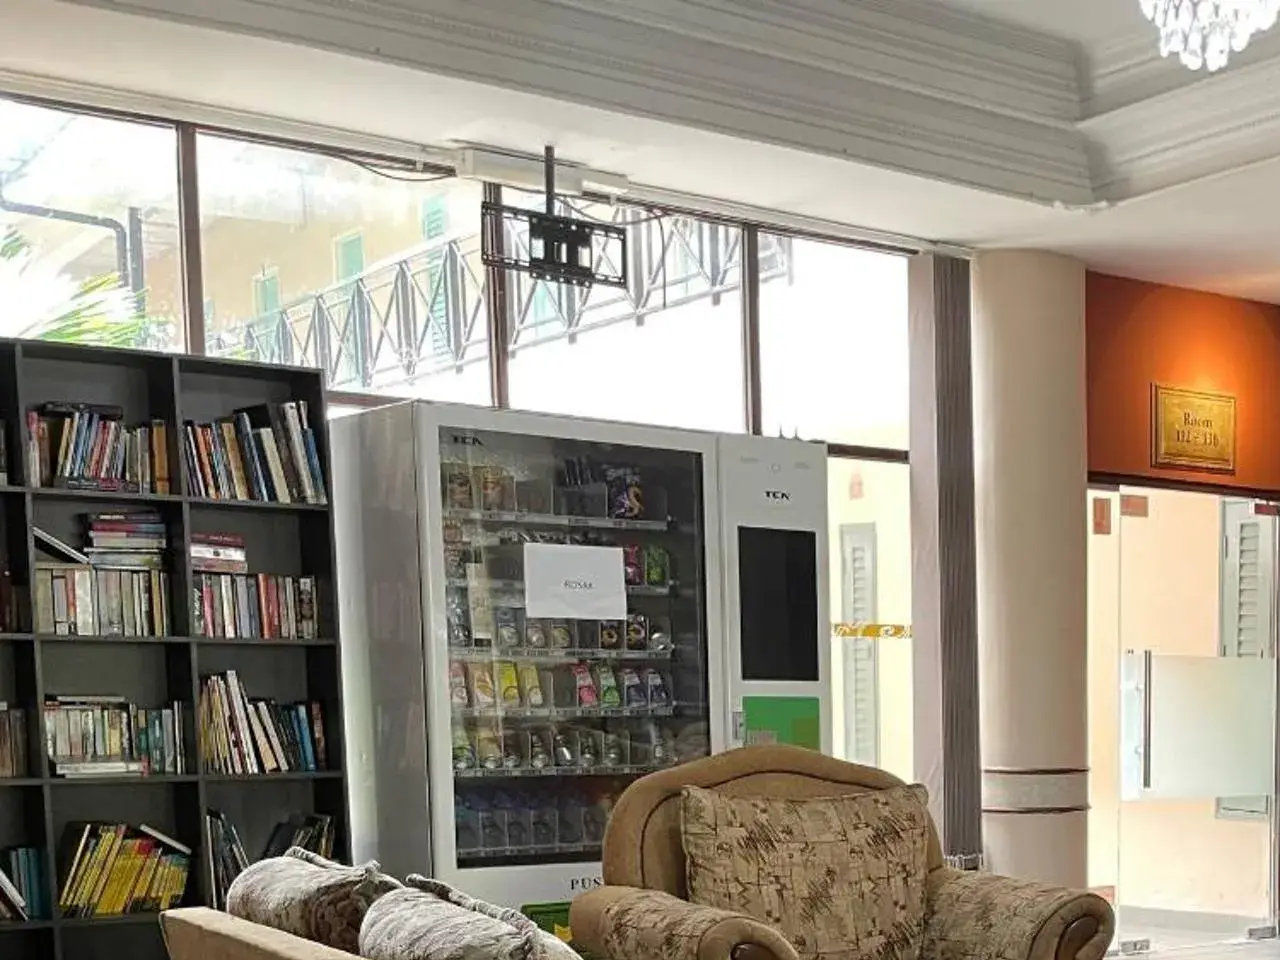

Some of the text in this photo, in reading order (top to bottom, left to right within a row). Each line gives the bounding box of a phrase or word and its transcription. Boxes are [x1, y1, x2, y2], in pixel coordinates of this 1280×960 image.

[1183, 411, 1213, 429] Room
[765, 490, 792, 501] TCN
[570, 877, 602, 891] PUS
